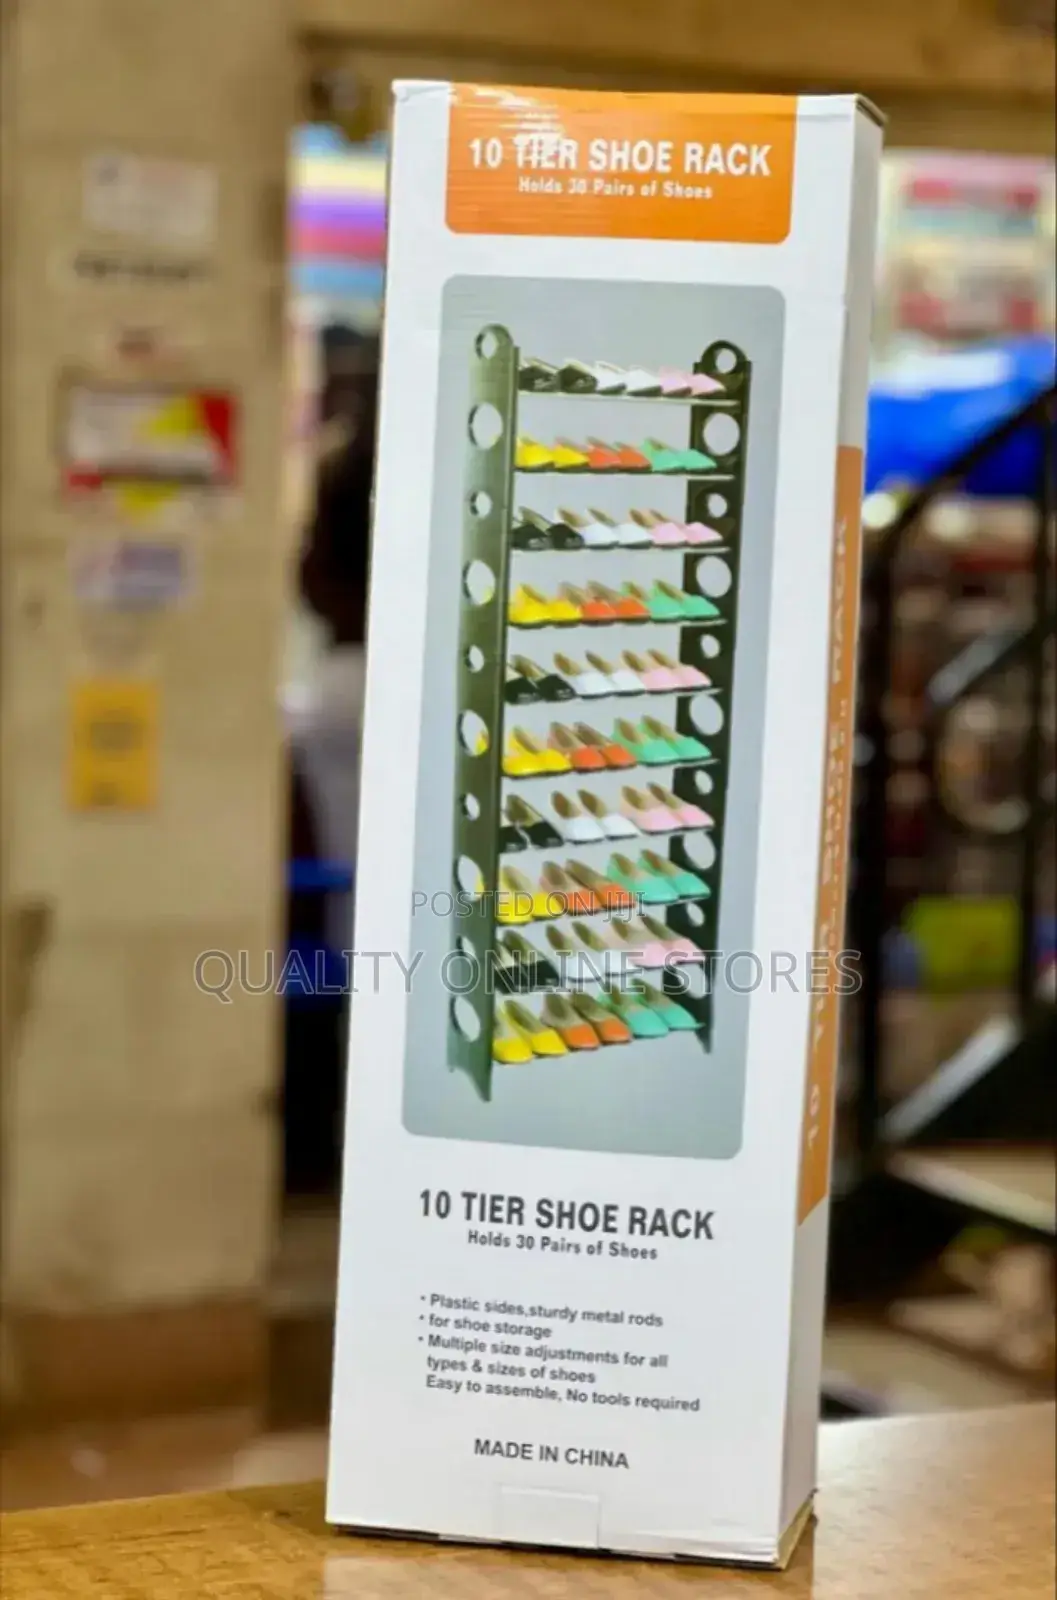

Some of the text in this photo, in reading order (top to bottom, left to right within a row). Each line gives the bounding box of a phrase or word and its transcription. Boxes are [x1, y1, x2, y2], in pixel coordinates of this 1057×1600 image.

[469, 134, 771, 176] 10 TIER SHOE RACK
[518, 176, 562, 193] Holds
[593, 179, 635, 196] Pairs
[640, 180, 656, 196] of
[663, 180, 713, 199] Shoes
[420, 1189, 715, 1240] 10 TIER SHOE RACK
[468, 1230, 658, 1260] Holds 30 Pairs of Shoes
[430, 1293, 480, 1311] Plastic
[581, 1306, 624, 1323] metal
[628, 1312, 664, 1327] rods
[429, 1313, 552, 1340] for shoe storage
[428, 1333, 669, 1368] Multiple size adjustments for all
[426, 1355, 596, 1384] types & sizes of shoes
[426, 1374, 701, 1412] Easy to assemble, No tools required
[474, 1438, 630, 1469] MADE IN CHINA
